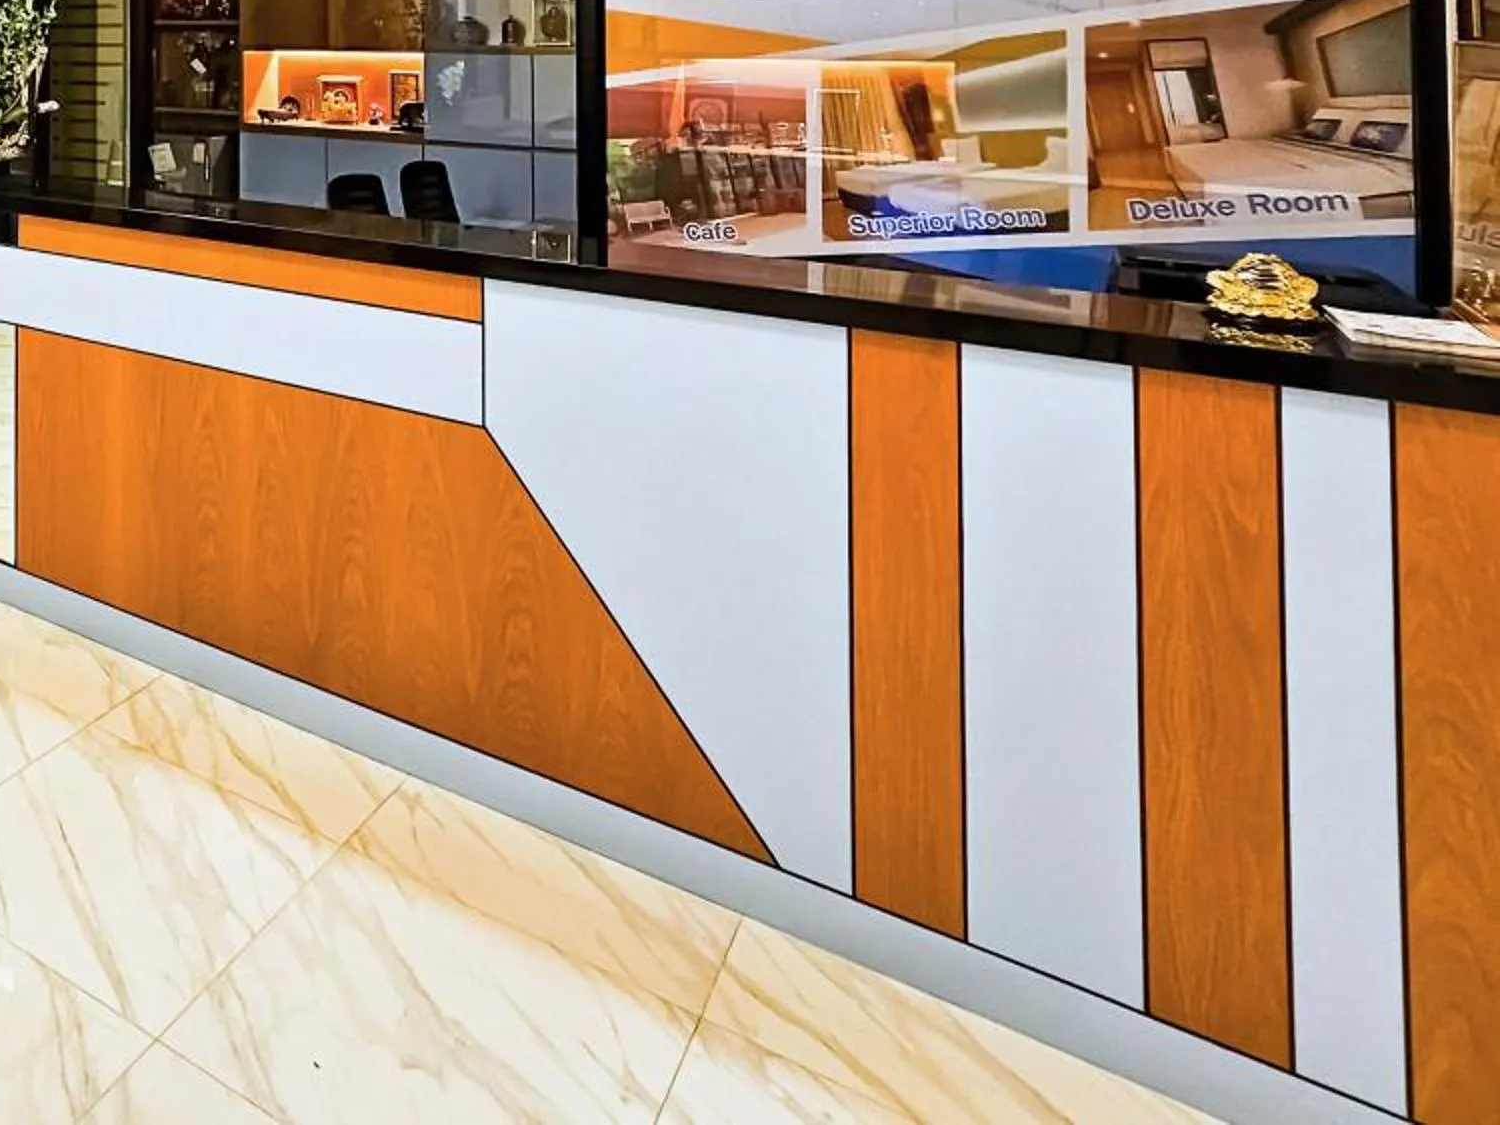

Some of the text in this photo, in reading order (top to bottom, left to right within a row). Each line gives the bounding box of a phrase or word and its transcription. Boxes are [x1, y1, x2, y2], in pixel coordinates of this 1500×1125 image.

[1129, 193, 1350, 221] Deluxe Room
[685, 221, 737, 242] Cafe
[849, 207, 1047, 237] Superior Room
